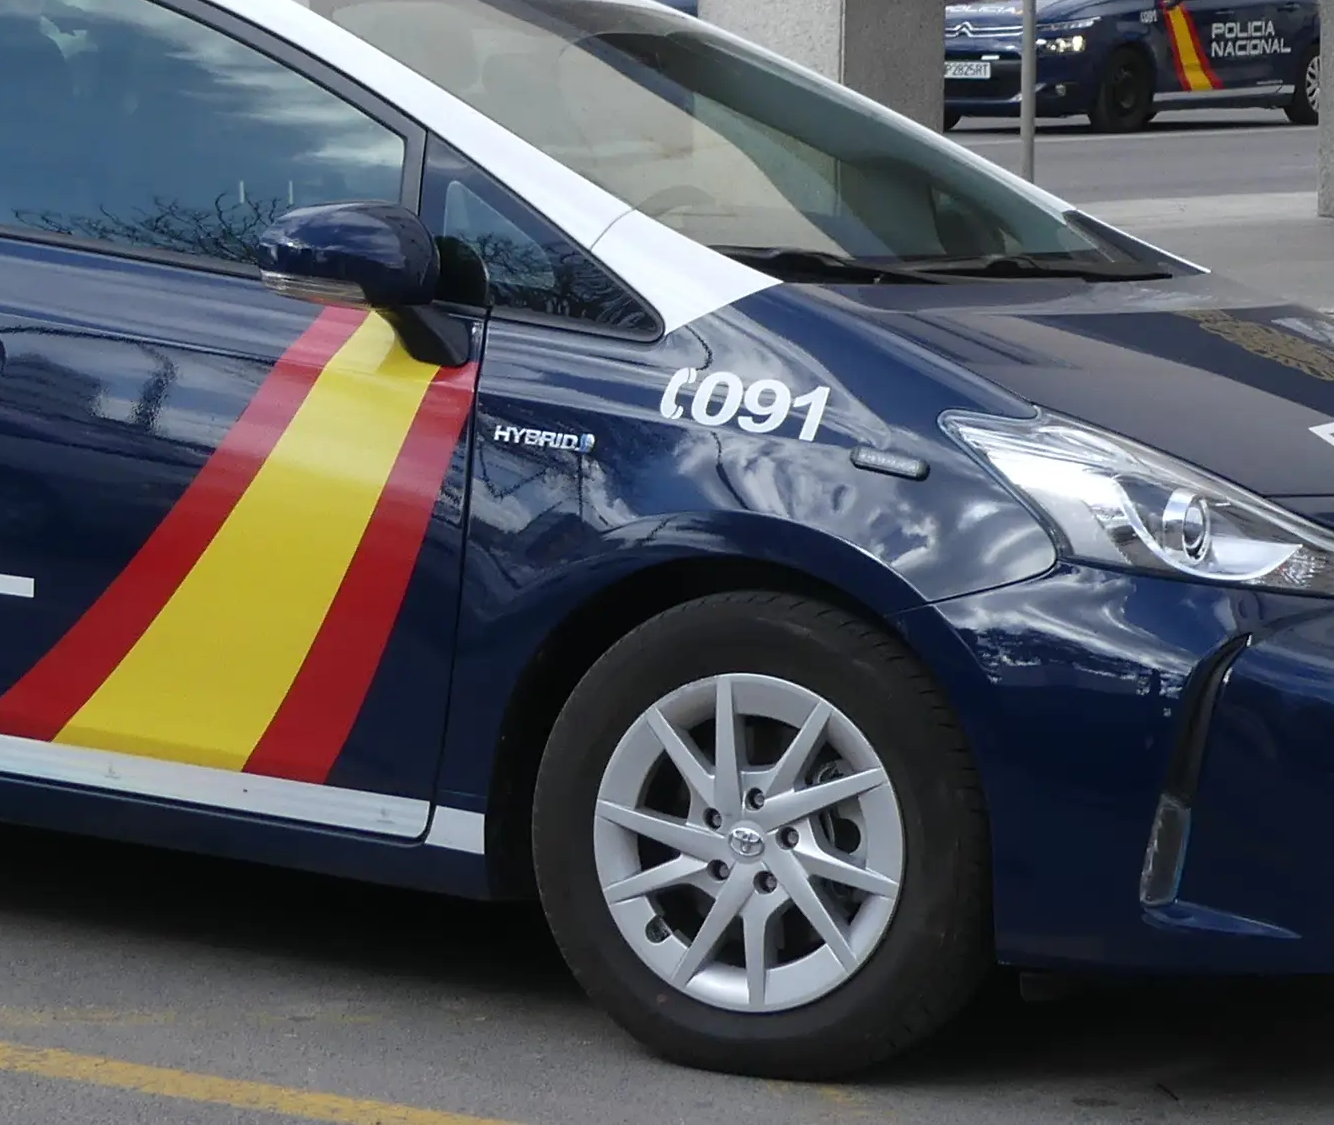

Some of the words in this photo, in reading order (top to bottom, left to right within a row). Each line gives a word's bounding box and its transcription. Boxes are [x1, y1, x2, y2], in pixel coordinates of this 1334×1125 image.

[1211, 37, 1292, 58] NACIONAL
[691, 371, 831, 443] 091
[493, 425, 579, 451] HYBRID
